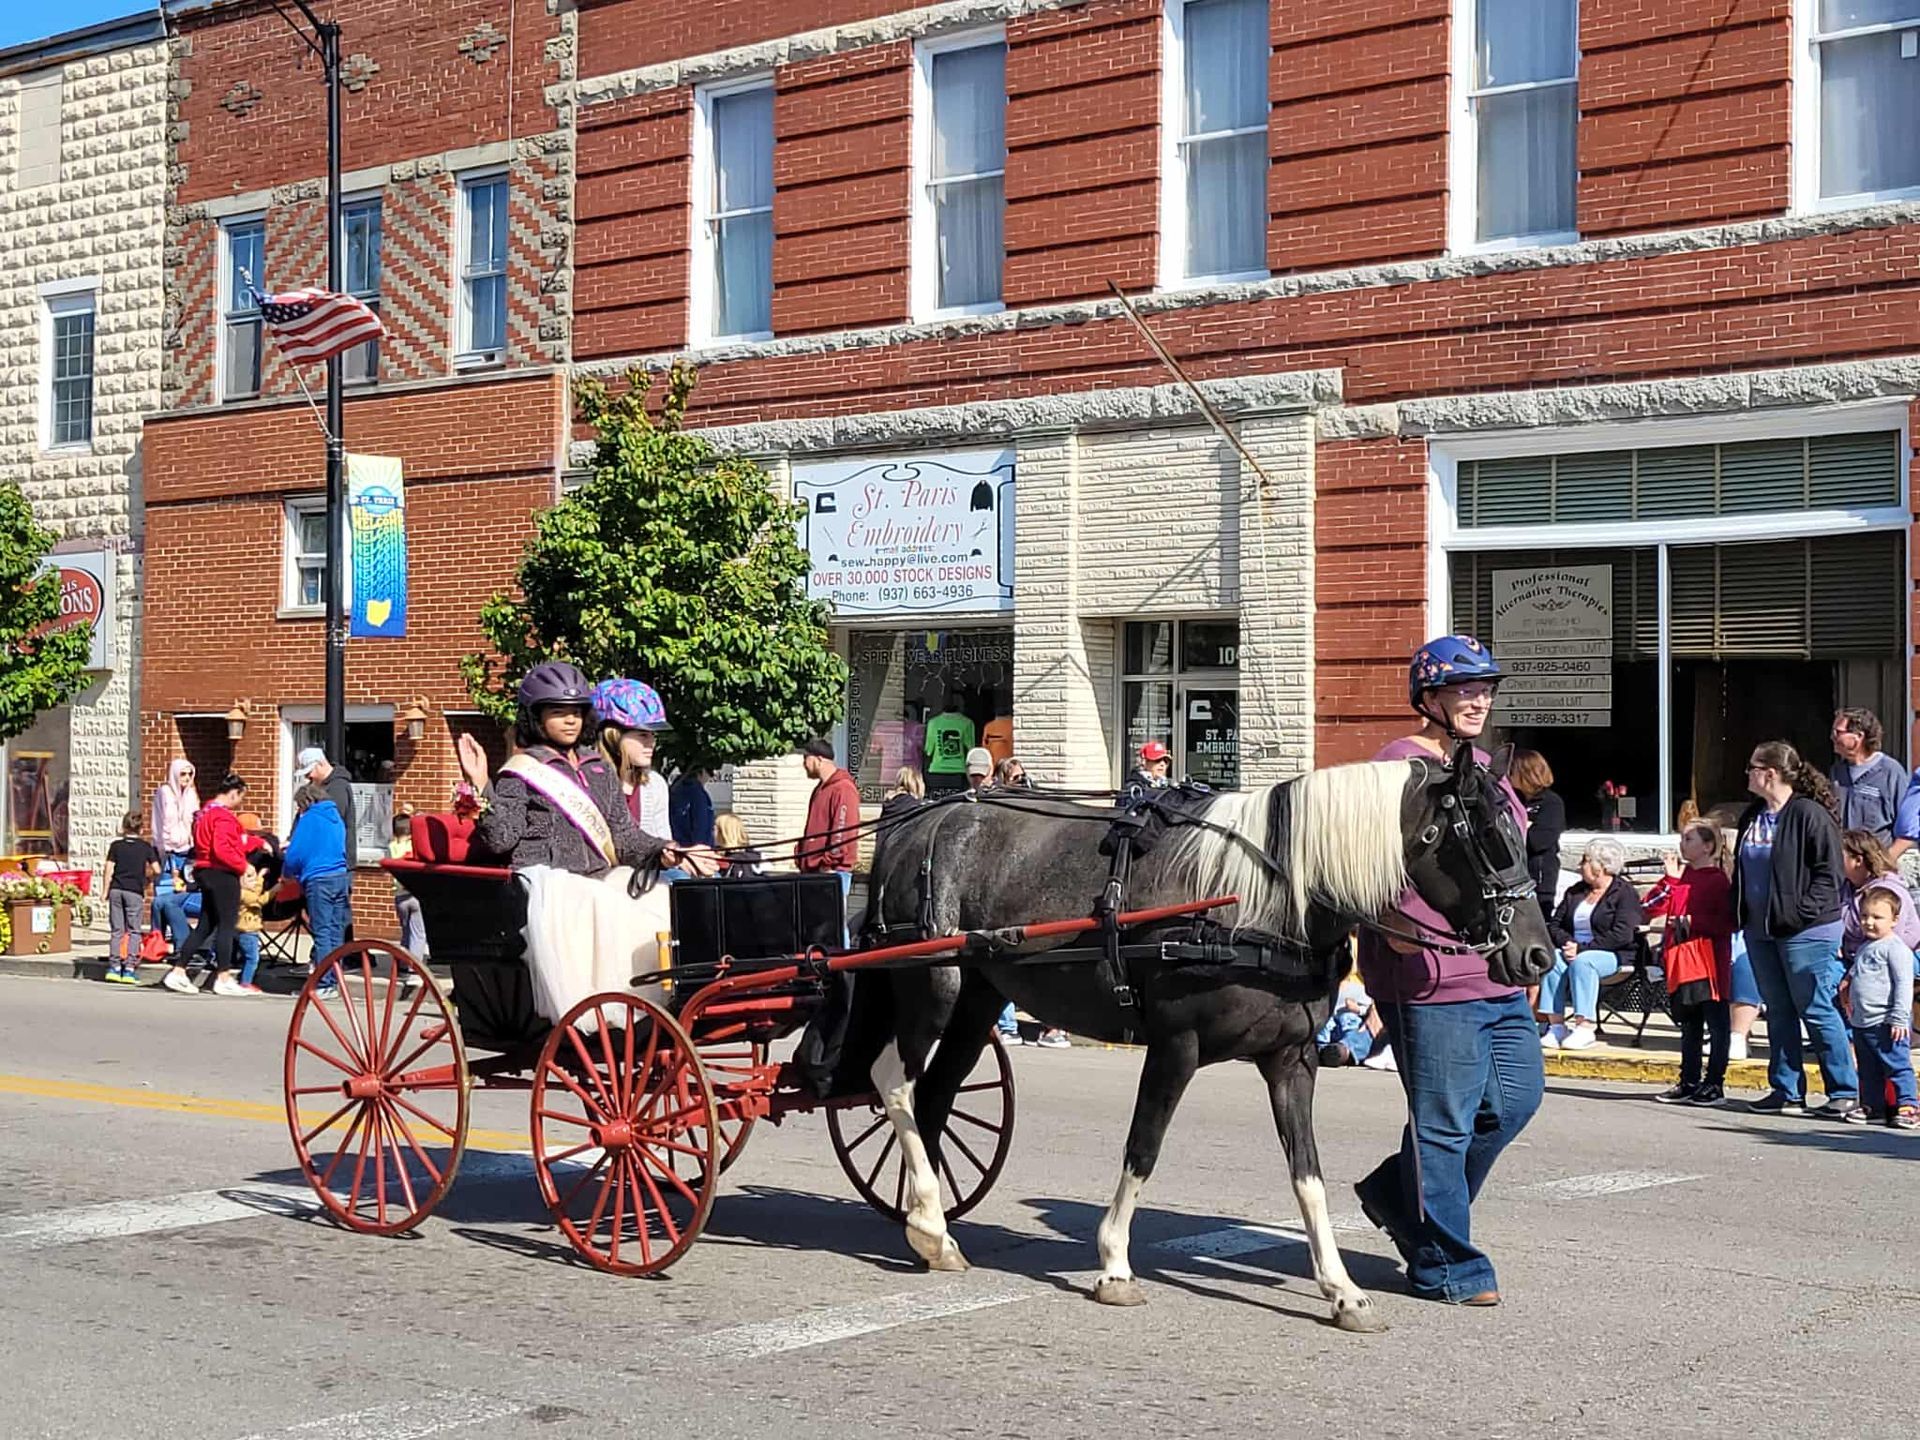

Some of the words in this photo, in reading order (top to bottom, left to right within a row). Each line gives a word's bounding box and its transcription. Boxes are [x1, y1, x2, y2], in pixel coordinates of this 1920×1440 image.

[852, 482, 889, 519] St.
[901, 477, 958, 508] Paris
[847, 516, 963, 548] Embroidery
[841, 552, 968, 568] sew_happy@live.com
[813, 572, 843, 587] OVER
[847, 569, 889, 585] 30,000
[893, 567, 933, 583] STOCK
[938, 565, 992, 581] DESIGNS
[1511, 571, 1591, 591] Professional
[832, 589, 869, 602] Phone:
[878, 587, 908, 601] (937)
[913, 585, 974, 599] 663-4936
[1496, 586, 1552, 618] Alternative
[1557, 585, 1608, 616] Therapies
[1218, 646, 1240, 665] 10
[1512, 661, 1591, 673] 937-925-0460
[1510, 713, 1591, 725] 937-869-3317
[1205, 729, 1223, 741] ST.
[1196, 741, 1240, 754] EMBROI
